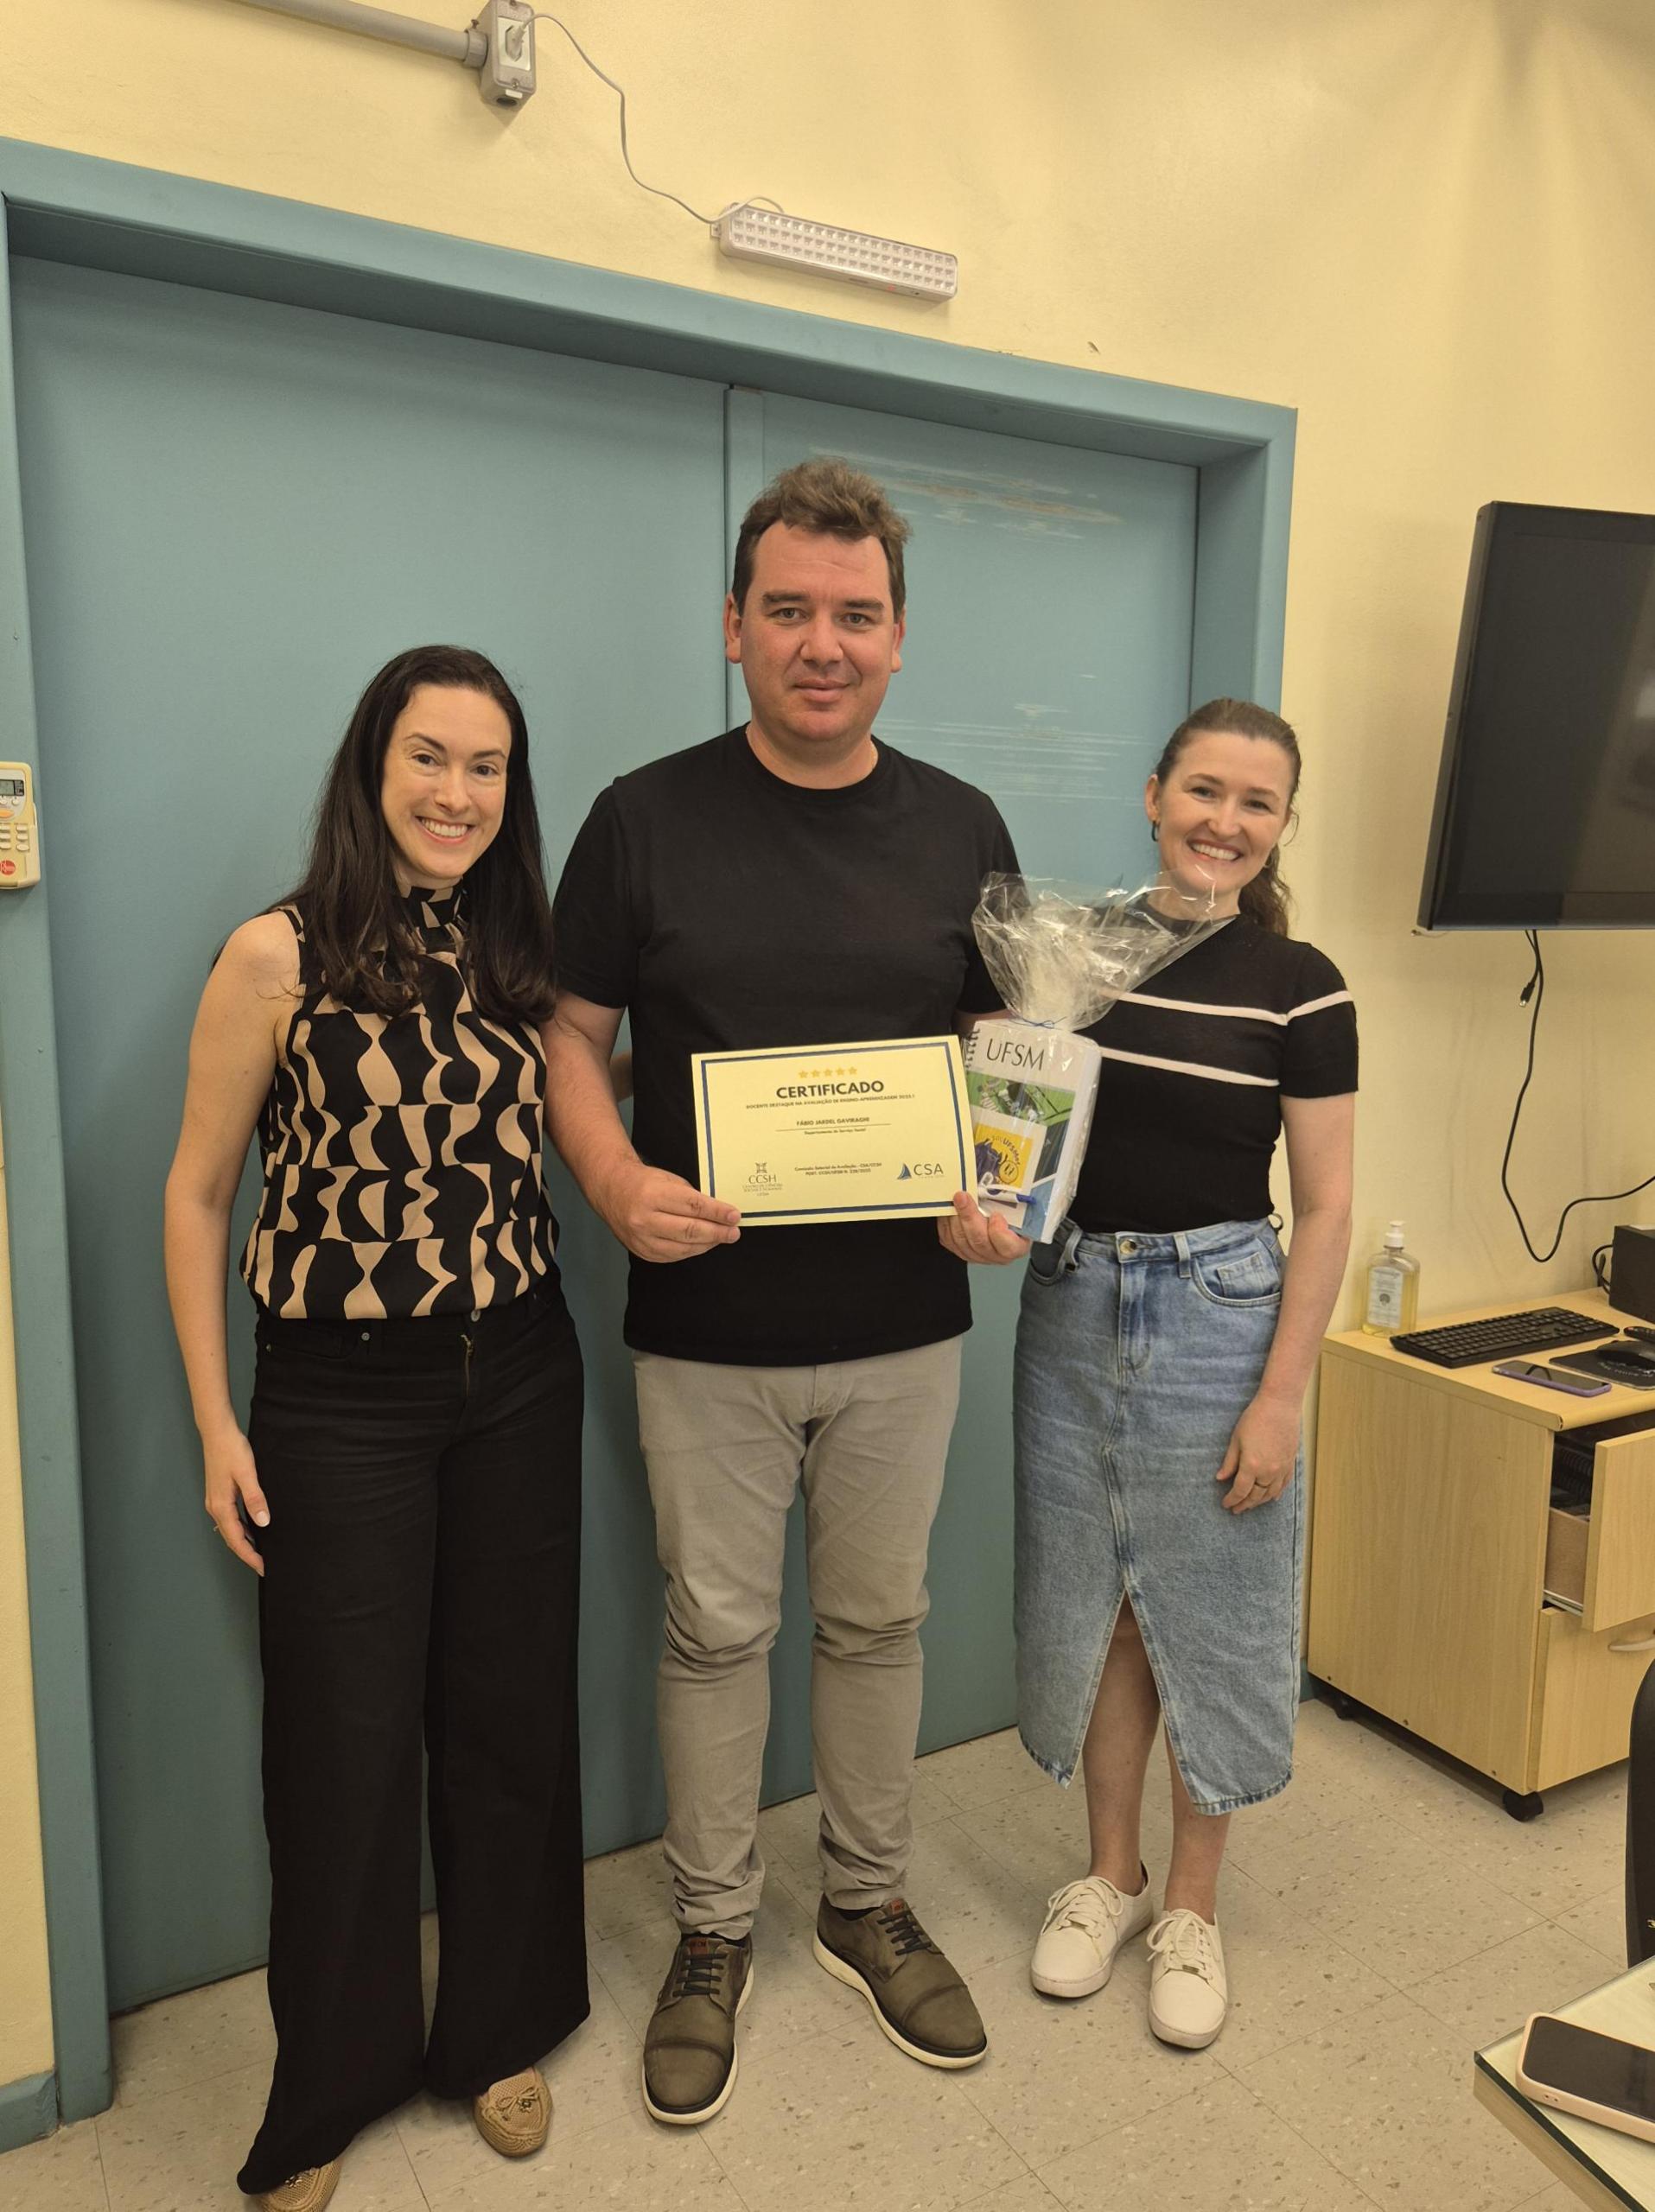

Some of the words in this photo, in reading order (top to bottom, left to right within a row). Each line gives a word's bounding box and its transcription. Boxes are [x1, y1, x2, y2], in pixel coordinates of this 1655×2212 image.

[986, 1038, 1044, 1071] UFSM
[776, 1080, 884, 1099] CERTIFICADO
[913, 1163, 944, 1176] CSA
[748, 1174, 777, 1184] CCSH
